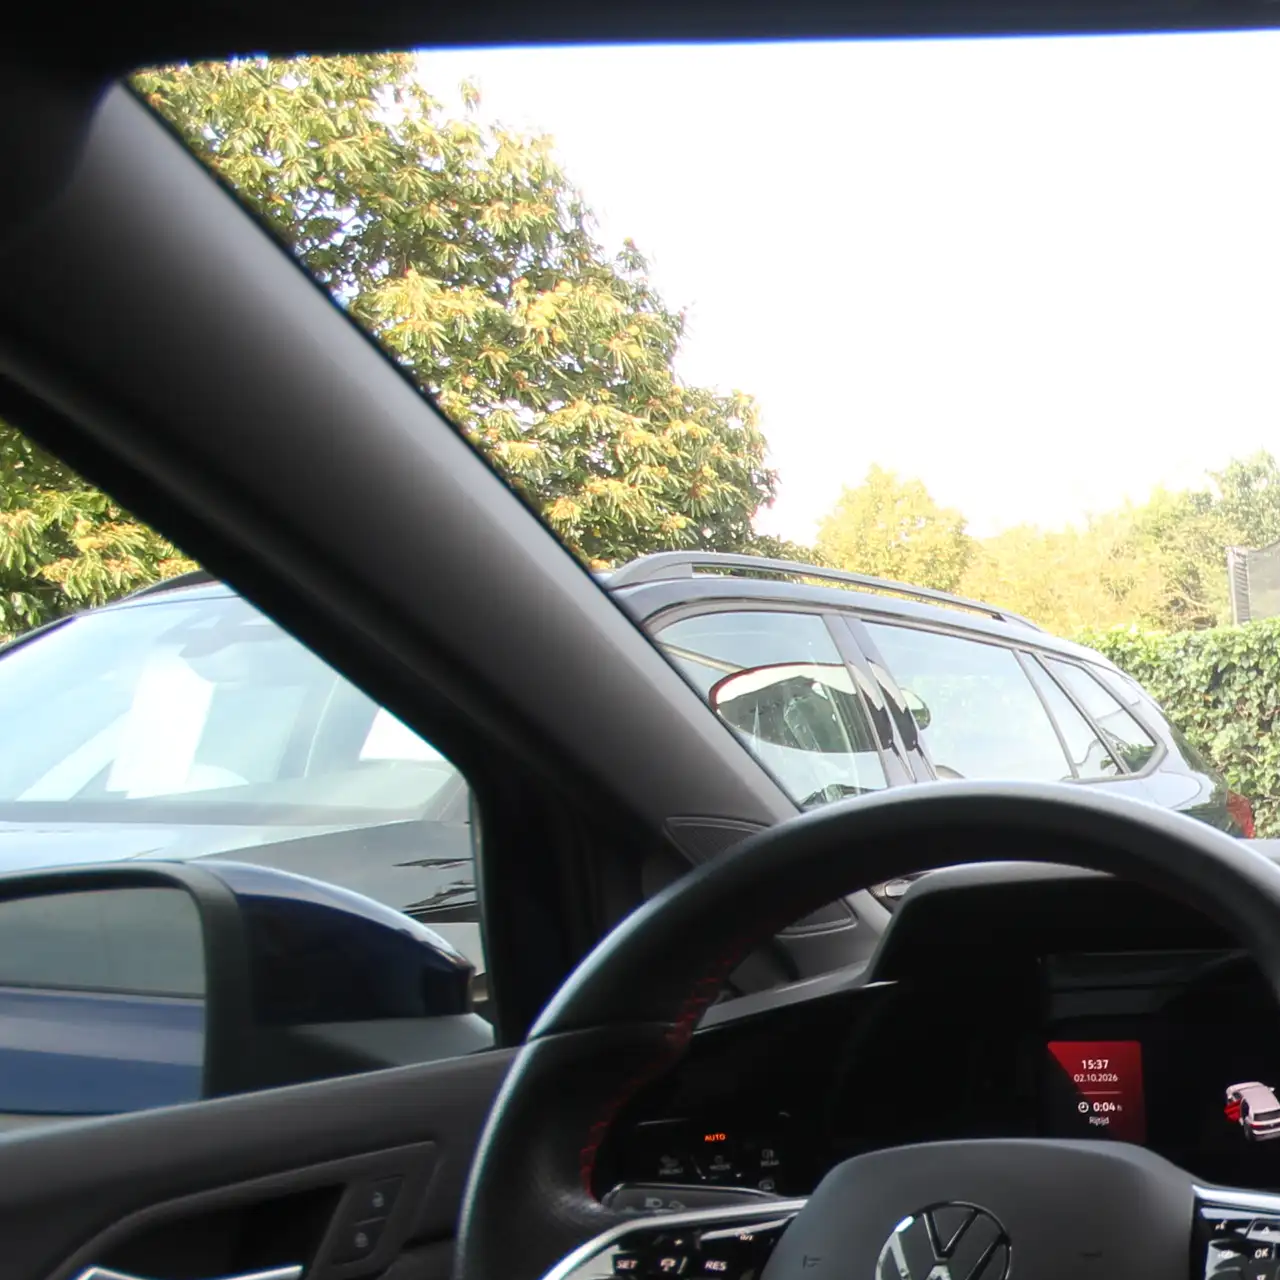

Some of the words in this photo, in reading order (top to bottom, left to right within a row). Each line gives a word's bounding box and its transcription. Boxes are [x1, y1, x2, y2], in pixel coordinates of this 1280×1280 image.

[1081, 1059, 1109, 1070] 15:37
[1093, 1102, 1116, 1112] 0:04
[704, 1132, 727, 1142] AUTO
[1254, 1248, 1269, 1260] OK
[616, 1259, 638, 1270] SET
[704, 1260, 728, 1272] RES
